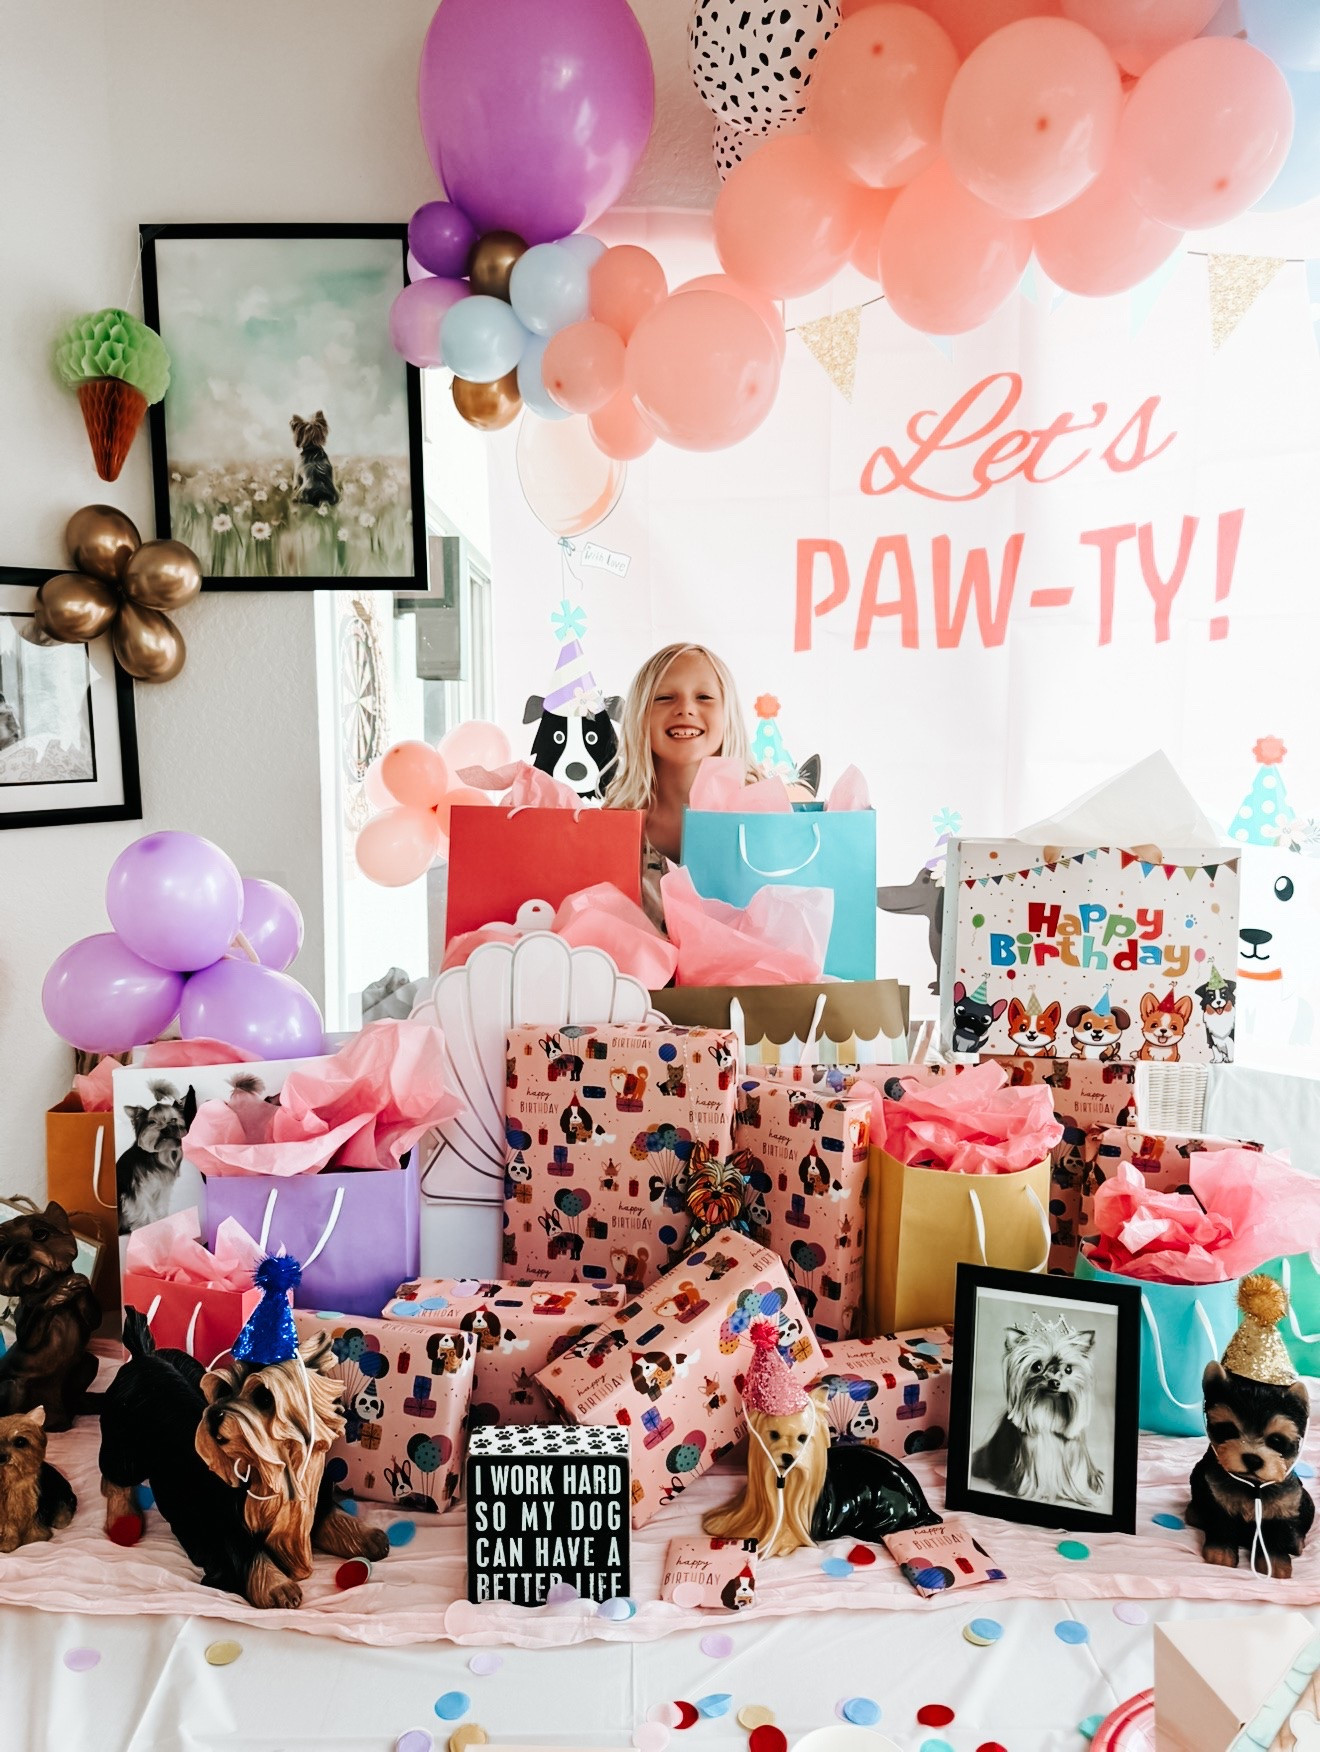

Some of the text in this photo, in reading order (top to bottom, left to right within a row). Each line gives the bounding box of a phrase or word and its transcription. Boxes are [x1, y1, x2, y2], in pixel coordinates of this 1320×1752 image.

[860, 371, 1178, 502] Let's
[793, 507, 1246, 653] PAW-TY!
[1028, 901, 1164, 947] Happy
[989, 932, 1190, 978] Birthday
[611, 1037, 653, 1050] BIRTHDAY
[526, 1087, 552, 1101] happy
[1080, 1088, 1108, 1102] happy
[519, 1101, 559, 1114] BIRTHDAY
[695, 1095, 723, 1111] happy
[1074, 1101, 1115, 1114] BIRTHDAY
[768, 1129, 792, 1146] happy
[762, 1142, 799, 1161] BIRTHDAY
[618, 1201, 645, 1216] happy
[611, 1215, 653, 1230] BIRTHDAY
[525, 1264, 553, 1279] happy
[846, 1351, 876, 1359] happy
[846, 1356, 892, 1370] BIRTHDAY
[576, 1373, 607, 1396] happy
[577, 1373, 625, 1415] BIRTHDAY
[475, 1465, 622, 1495] I WORK HARD
[475, 1500, 621, 1531] SO MY DOG
[912, 1526, 946, 1535] happy
[912, 1533, 966, 1551] BIRTHDAY
[476, 1536, 621, 1567] CAN HAVE A
[676, 1555, 712, 1569] happy
[663, 1572, 721, 1586] BIRTHDAY
